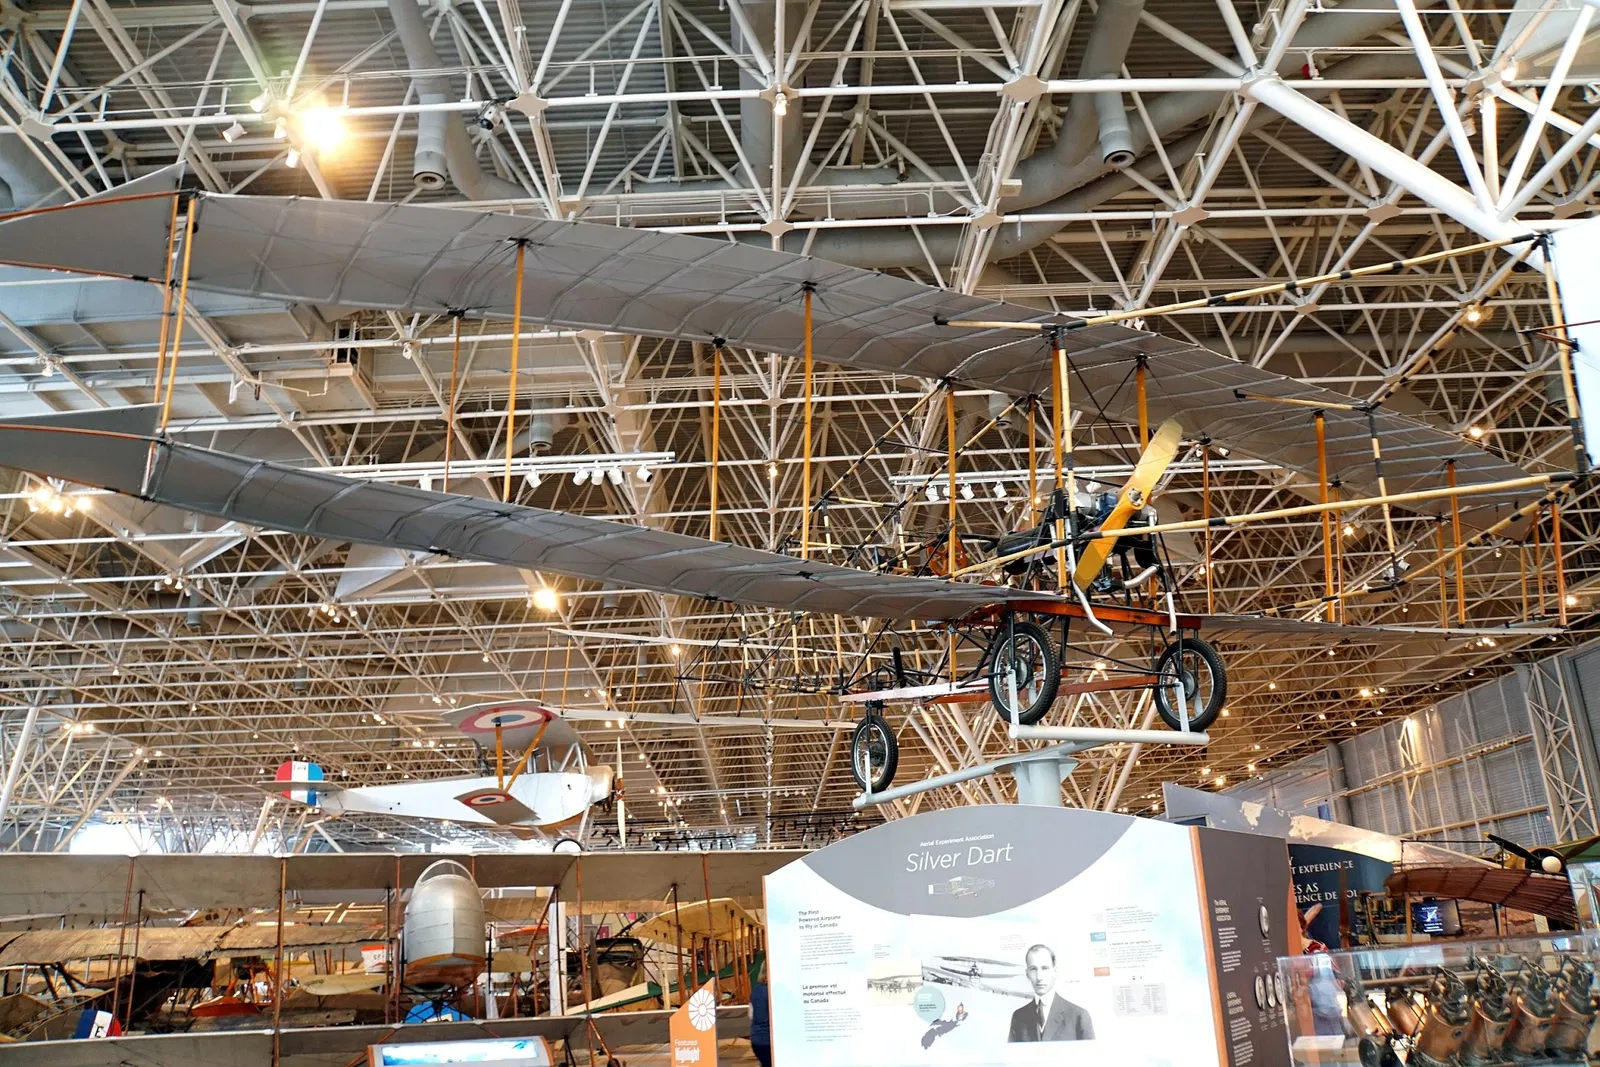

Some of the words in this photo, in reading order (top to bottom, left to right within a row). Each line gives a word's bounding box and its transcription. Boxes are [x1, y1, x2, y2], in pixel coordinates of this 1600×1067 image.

[935, 837, 964, 845] Experiment
[965, 833, 994, 842] Association
[906, 851, 961, 872] Silver
[967, 843, 1014, 866] Dart
[1298, 860, 1354, 874] EXPERIENCE
[1306, 882, 1319, 893] AS
[1325, 892, 1338, 901] DE
